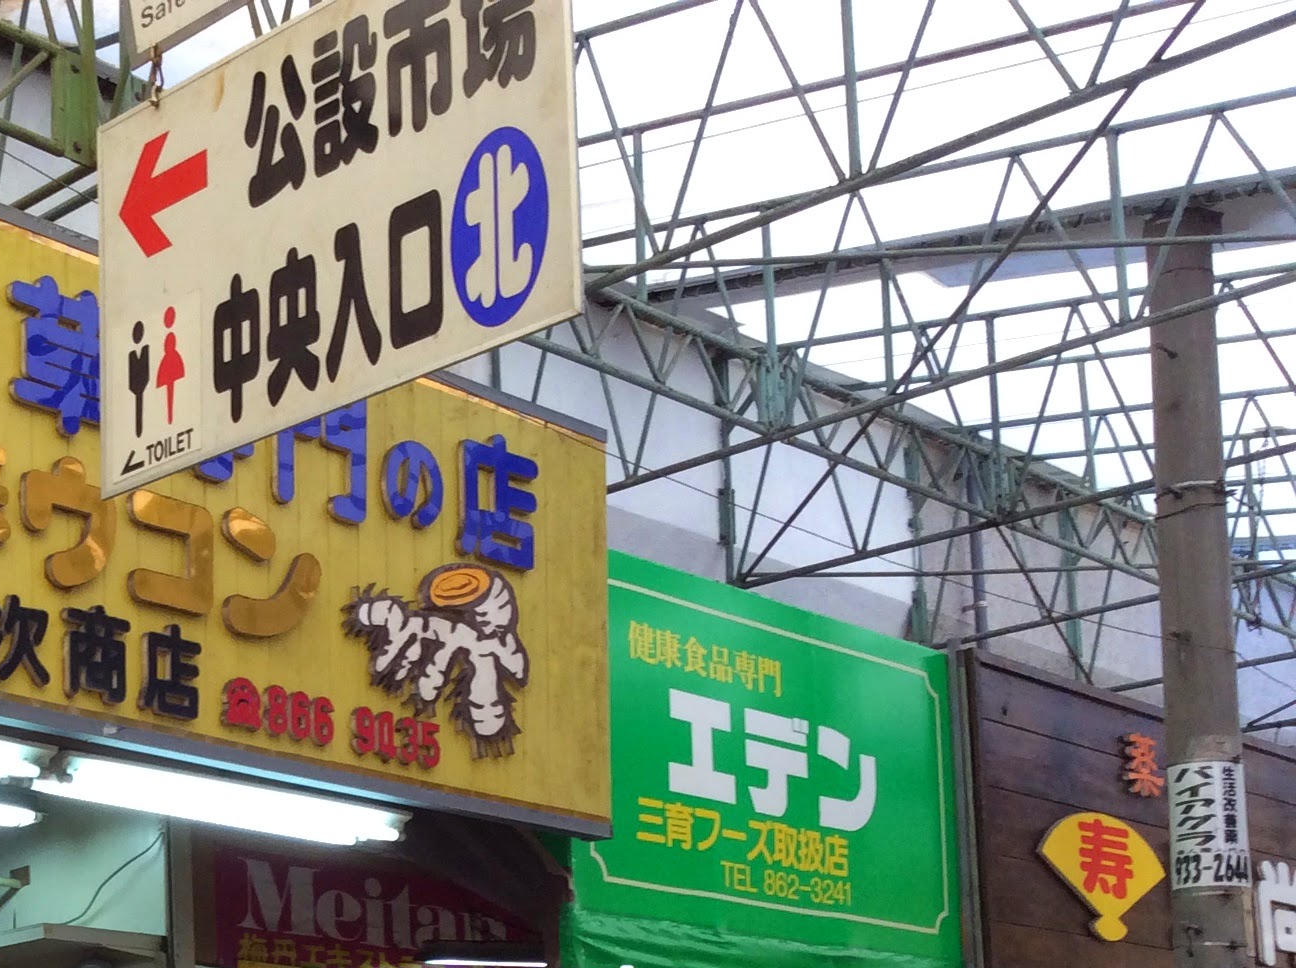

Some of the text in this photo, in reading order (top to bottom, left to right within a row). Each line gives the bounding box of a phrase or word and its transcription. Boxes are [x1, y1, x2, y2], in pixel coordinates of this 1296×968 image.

[245, 0, 536, 207] 公設市場
[464, 144, 531, 310] 北
[212, 189, 444, 423] 中央入口
[144, 427, 194, 467] TOILET
[628, 621, 783, 698] 健康食品専門
[264, 684, 442, 769] 866 9035
[668, 688, 877, 832] エデン
[636, 796, 850, 877] 三育フーズ取扱店
[1078, 819, 1134, 900] 寿
[720, 861, 852, 907] TEL 862-3241
